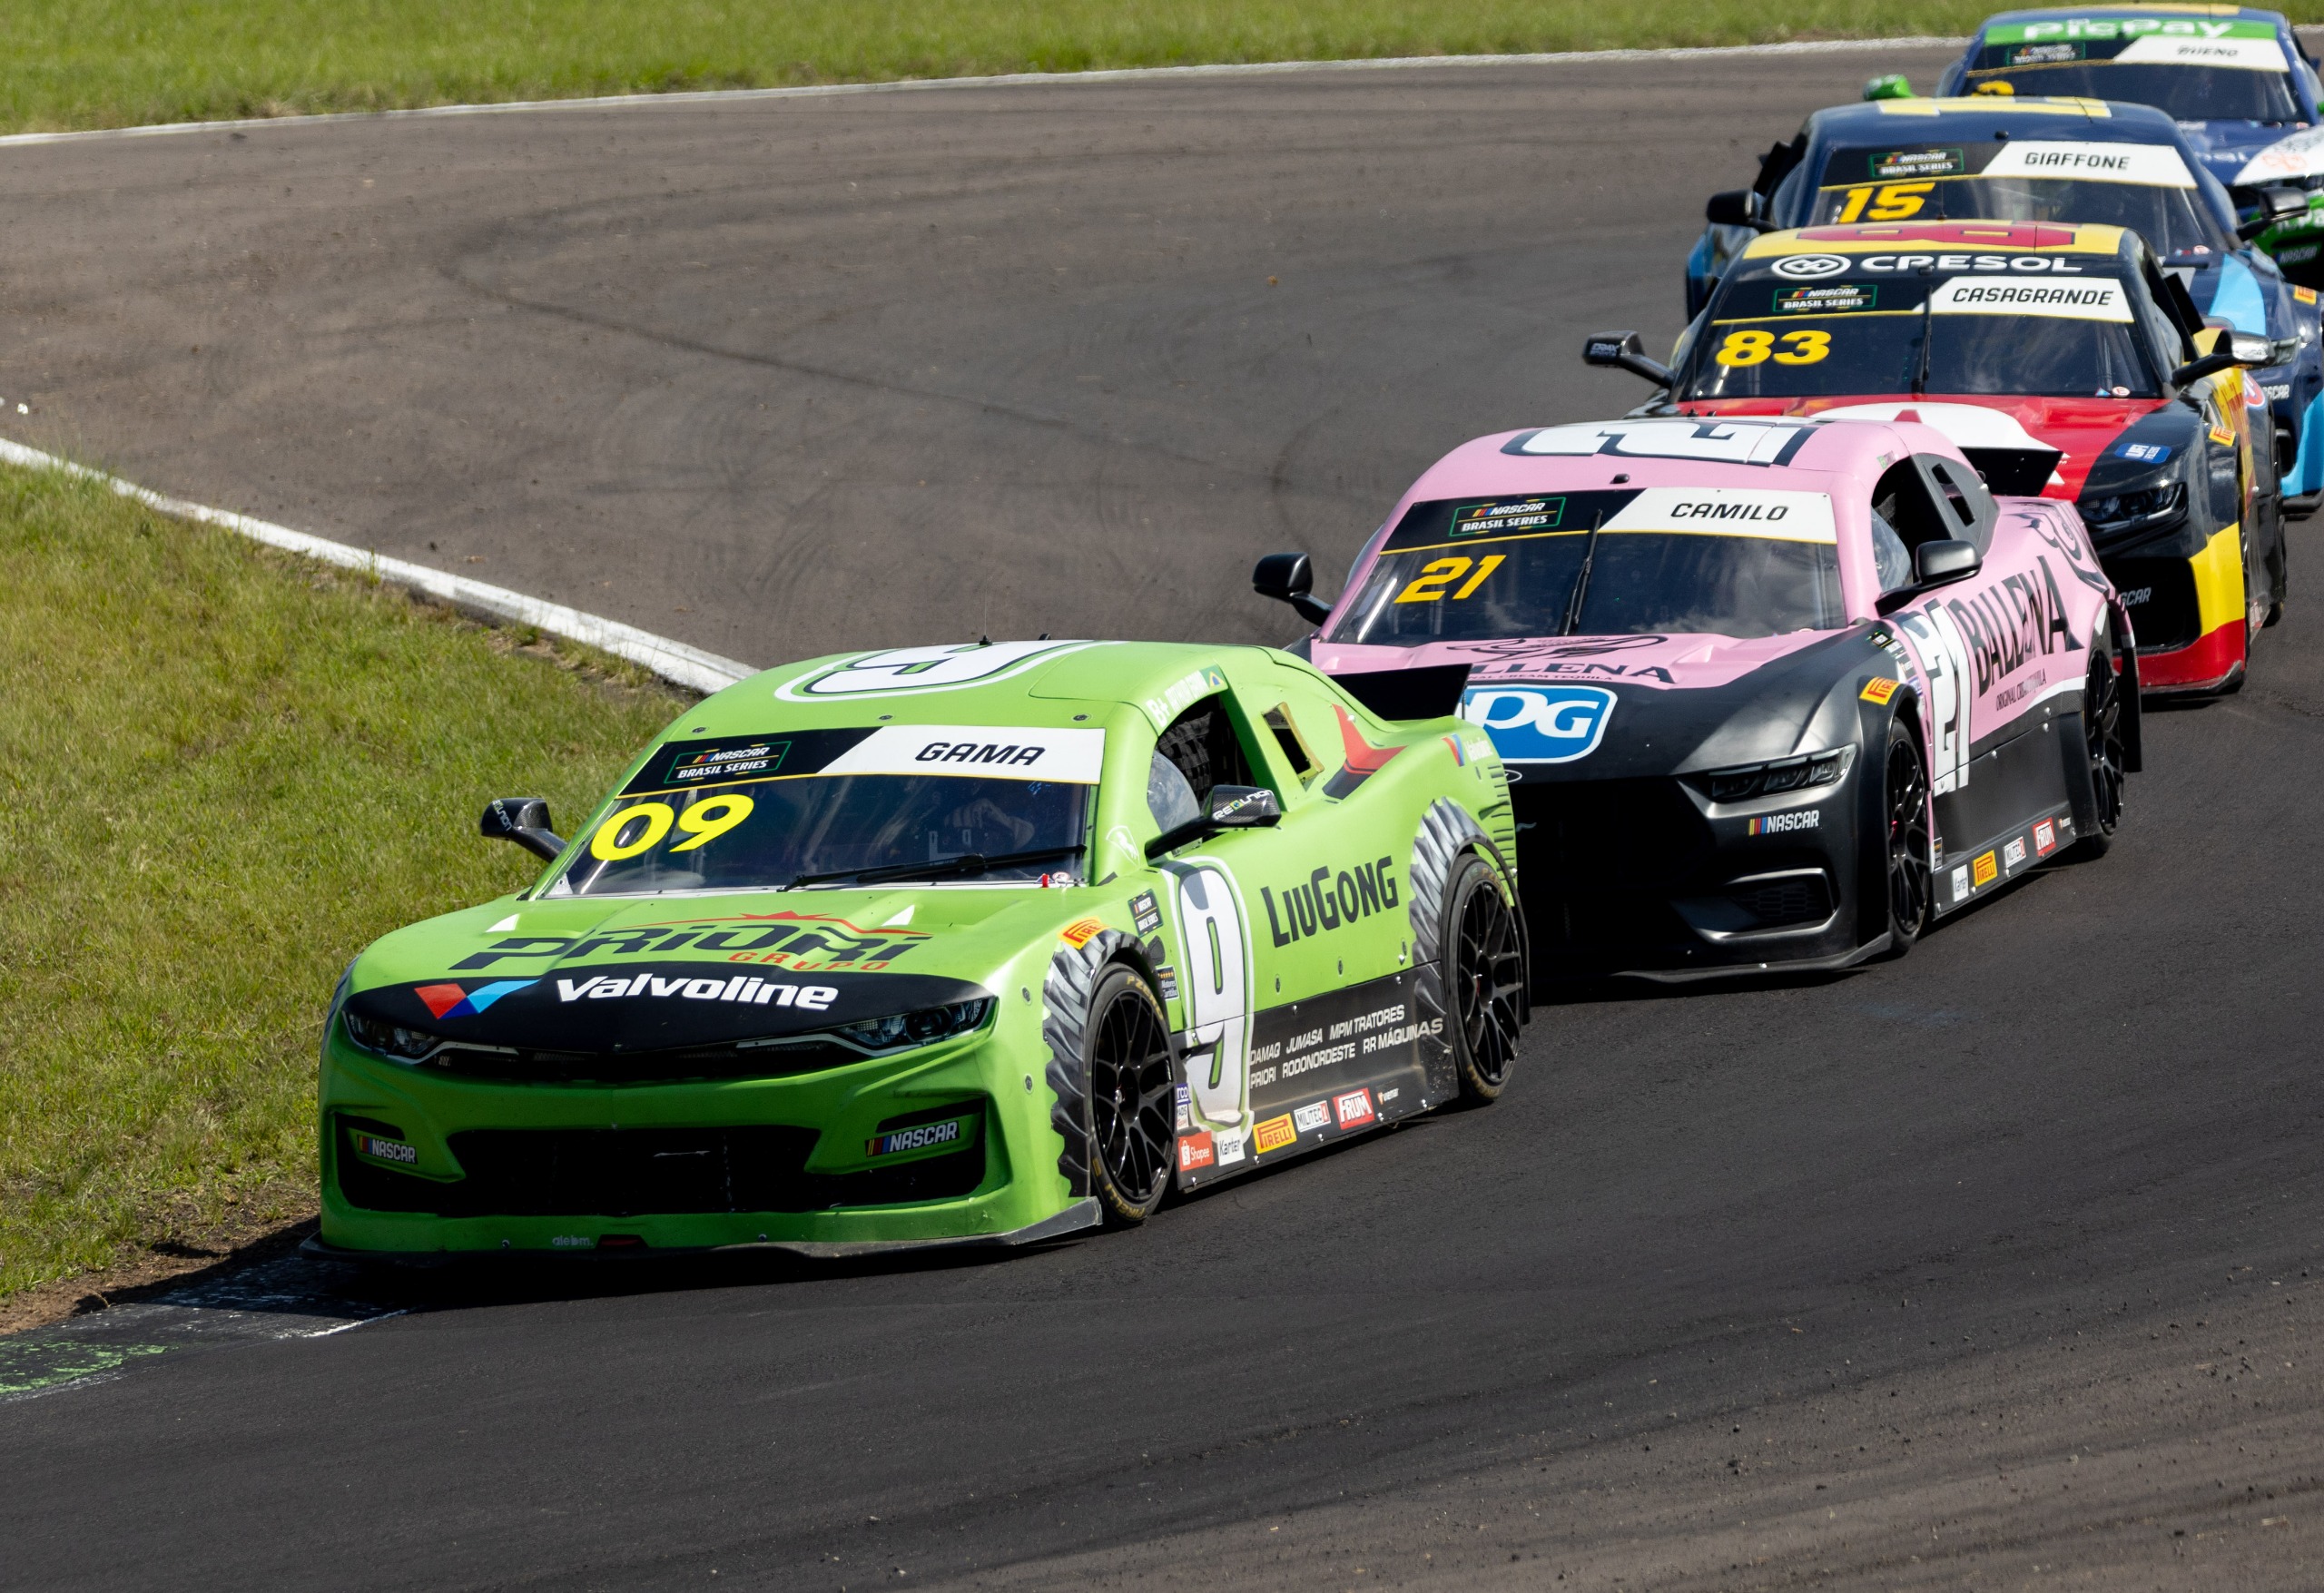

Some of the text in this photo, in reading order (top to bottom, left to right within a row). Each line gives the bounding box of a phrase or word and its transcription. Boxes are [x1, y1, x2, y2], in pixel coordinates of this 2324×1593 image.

[2024, 152, 2131, 171] GIAFFONE
[1837, 182, 1935, 224] 15
[1860, 254, 2083, 272] CRESOL
[1783, 297, 1864, 310] BRASIL SERIES
[1807, 287, 1859, 299] NASCAR
[1953, 287, 2114, 306] CASAGRANDE
[1716, 329, 1832, 368] 83
[1489, 502, 1546, 516] NASCAR
[1670, 502, 1790, 522] CAMILO
[1461, 515, 1549, 533] BRASIL SERIES
[1394, 555, 1507, 603] 21
[2120, 586, 2152, 607] SCAR
[1471, 663, 1677, 684] LLENA
[1456, 691, 1600, 739] PG
[710, 746, 770, 762] NASCAR
[914, 742, 1046, 767] GAMA
[676, 759, 769, 779] BRASIL SERIES
[590, 793, 754, 861] 09
[1767, 810, 1820, 834] NASCAR
[1975, 854, 1995, 883] PIRELLI
[727, 950, 895, 971] GRUPO
[556, 972, 840, 1011] Valvoline
[1285, 1028, 1323, 1055] JUMASA
[1329, 1018, 1354, 1041] MPM
[1353, 1004, 1405, 1033] TRATORES
[1250, 1066, 1276, 1089] PRIORI
[1363, 1037, 1378, 1055] RR
[1339, 1090, 1372, 1124] FRUM
[889, 1121, 958, 1153] NASCAR
[1257, 1118, 1293, 1150] PIRELLI
[371, 1139, 417, 1165] NASCAR
[1190, 1146, 1210, 1164] Shopee
[1219, 1136, 1242, 1157] Karter
